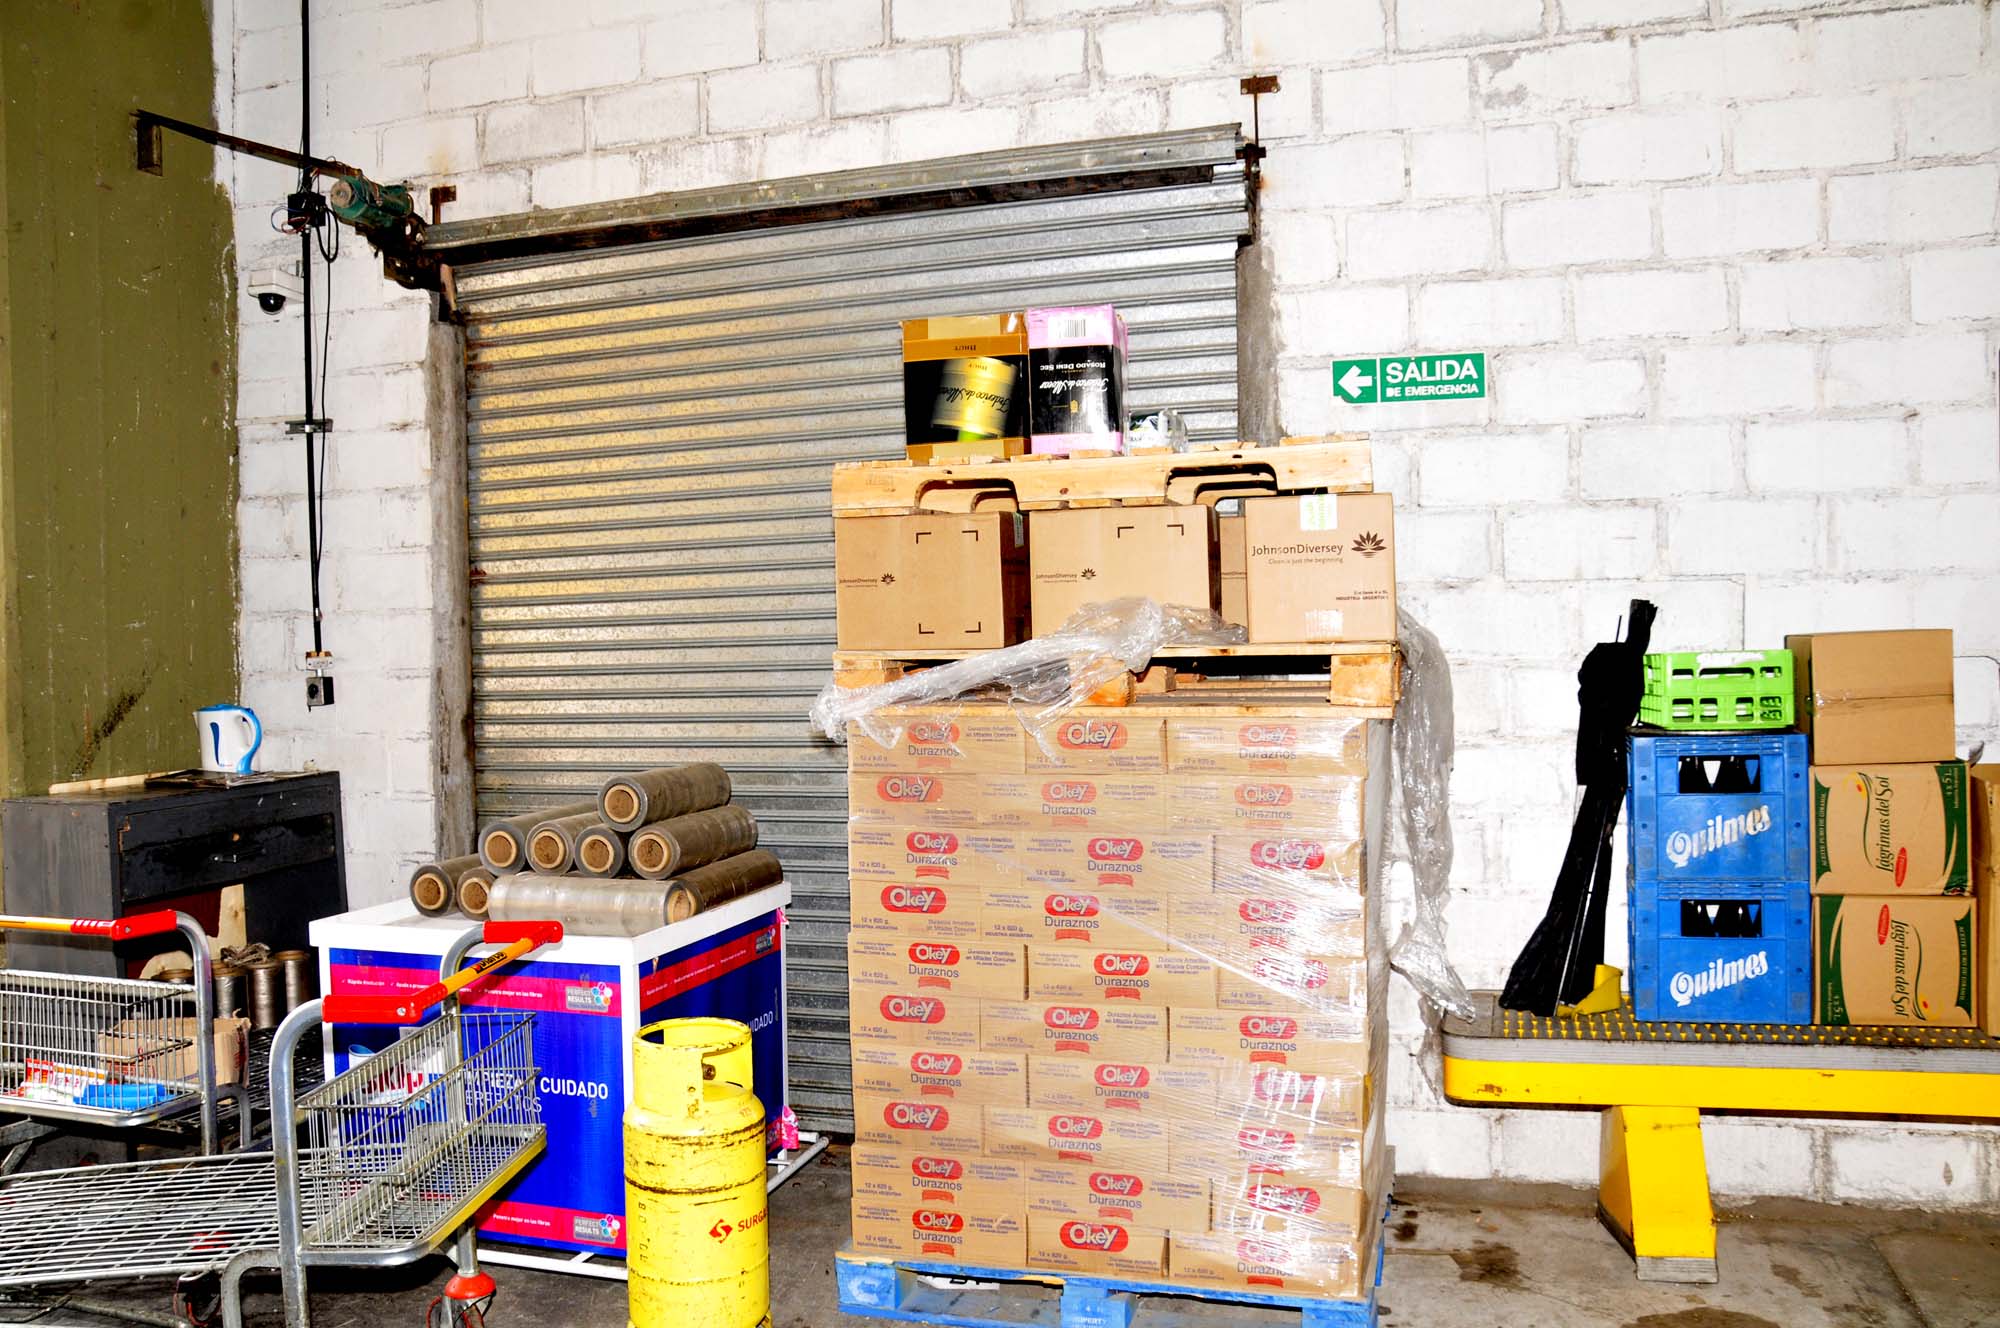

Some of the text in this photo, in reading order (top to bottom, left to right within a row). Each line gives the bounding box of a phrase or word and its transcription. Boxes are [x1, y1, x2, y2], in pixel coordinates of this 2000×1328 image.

[1386, 358, 1478, 384] SALIDA
[1386, 384, 1479, 398] DE EMERGENCIA
[1252, 544, 1344, 556] JohnsonDiversey
[1314, 557, 1344, 565] beginning
[1066, 721, 1118, 749] Okey
[908, 744, 960, 757] Duraznos
[1239, 747, 1297, 760] Duraznos
[886, 776, 934, 802] Okey
[1050, 783, 1089, 802] Okey
[1042, 803, 1096, 816] Duraznos
[1235, 807, 1293, 820] Duraznos
[1874, 776, 1896, 873] Lágrimas del Sol
[914, 832, 950, 852] Okey
[1666, 804, 1772, 868] Quilmes
[1094, 839, 1135, 859] Okey
[906, 853, 958, 866] Duraznos
[1087, 860, 1143, 873] Duraznos
[890, 887, 936, 913] Okey
[1052, 896, 1092, 915] Okey
[1044, 916, 1100, 929] Duraznos
[916, 944, 952, 964] Okey
[908, 964, 960, 978] Duraznos
[1102, 954, 1142, 974] Okey
[1890, 920, 1910, 1017] Lágrimas del Sol
[1094, 976, 1150, 988] Duraznos
[1669, 950, 1769, 1008] Quilmes
[568, 987, 593, 996] PERFECT
[568, 995, 592, 1004] RESULTS
[888, 998, 936, 1024] Okey
[1052, 1008, 1092, 1028] Okey
[1044, 1028, 1100, 1042] Duraznos
[1248, 1018, 1288, 1038] Okey
[1240, 1038, 1297, 1052] Duraznos
[918, 1054, 954, 1074] Okey
[910, 1073, 962, 1088] Duraznos
[1102, 1066, 1142, 1086] Okey
[540, 1077, 609, 1100] CUIDADO
[1094, 1086, 1150, 1100] Duraznos
[892, 1104, 940, 1130] Okey
[1056, 1117, 1096, 1137] Okey
[1048, 1138, 1102, 1152] Duraznos
[918, 1158, 954, 1177] Okey
[912, 1176, 962, 1192] Duraznos
[1096, 1175, 1135, 1195] Okey
[1088, 1193, 1143, 1209] Duraznos
[738, 1206, 768, 1233] SURGA
[920, 1211, 956, 1230] Okey
[575, 1226, 600, 1235] RESULTS
[912, 1230, 963, 1245] Duraznos
[1069, 1223, 1119, 1250] Okey
